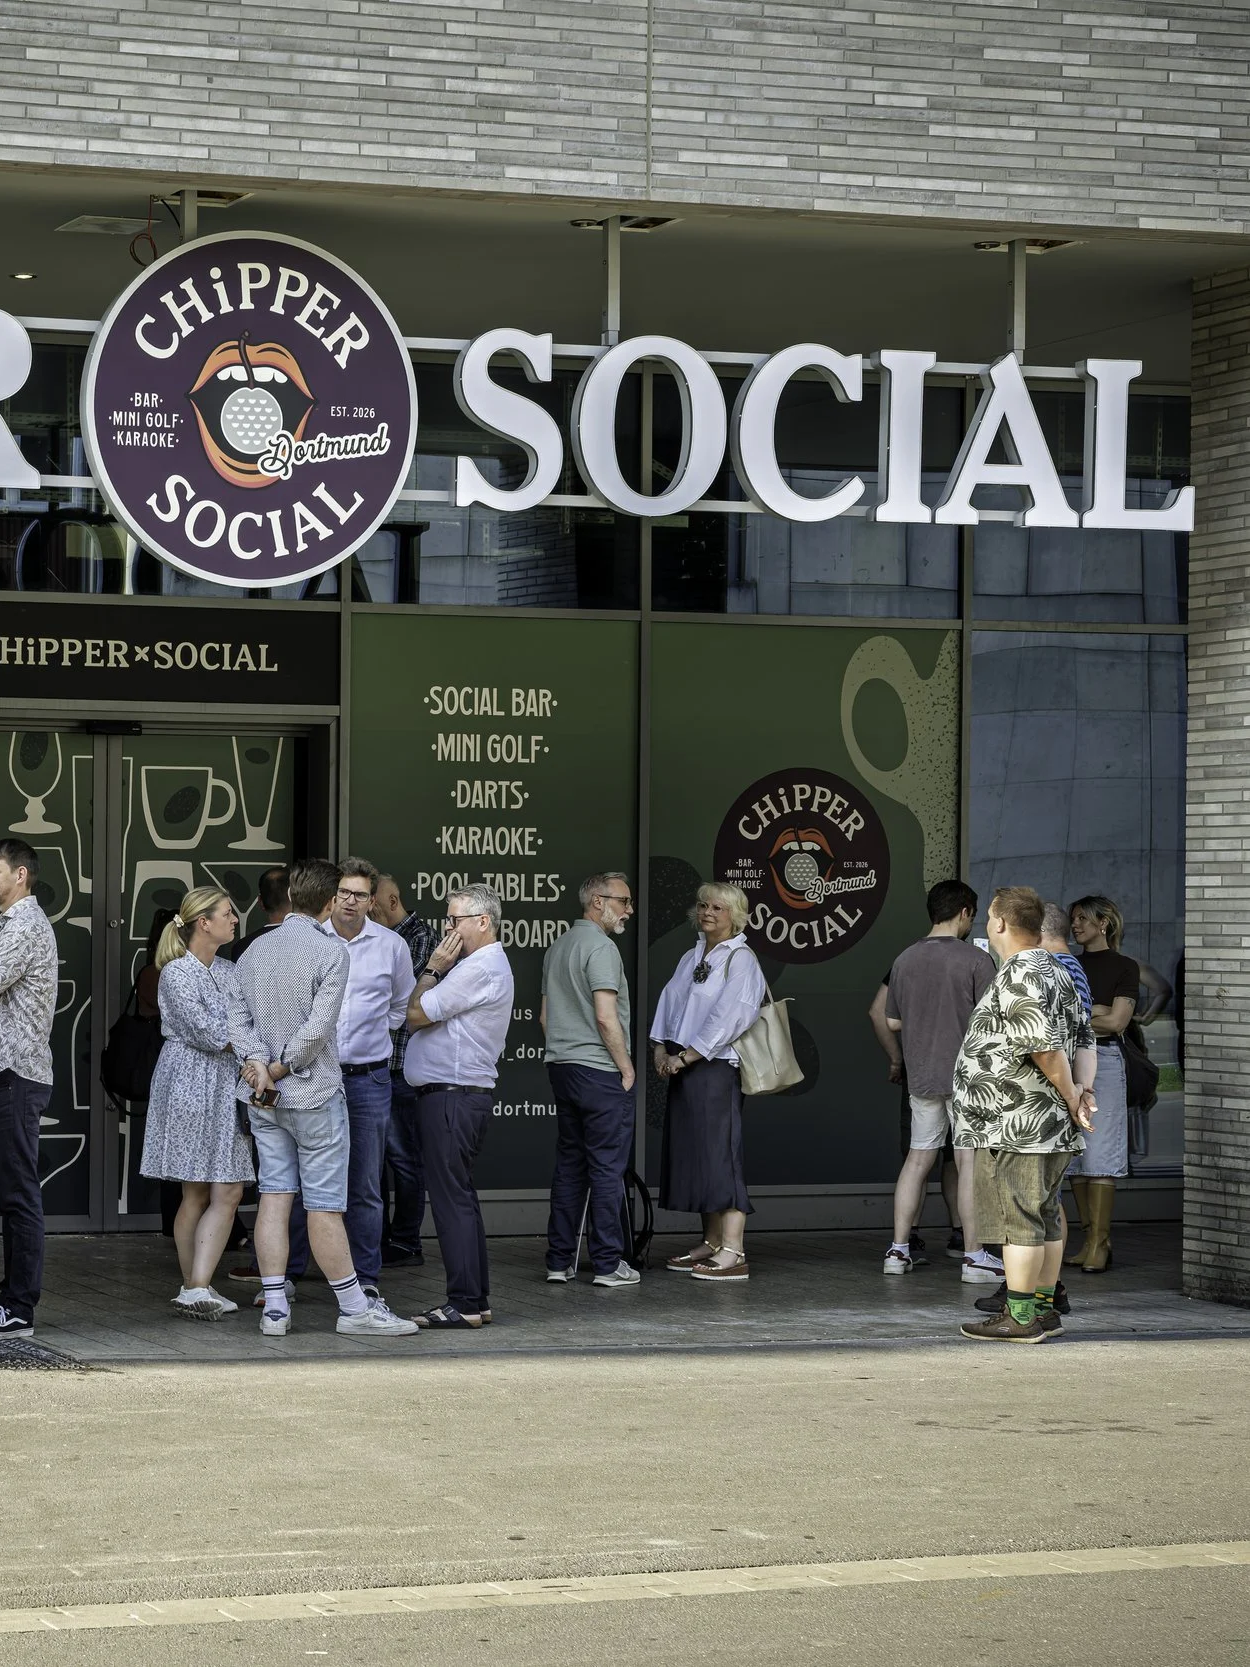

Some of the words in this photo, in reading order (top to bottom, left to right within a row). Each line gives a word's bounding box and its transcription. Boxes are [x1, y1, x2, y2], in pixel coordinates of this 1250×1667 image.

[330, 406, 350, 417] EST.
[352, 406, 376, 419] 2026
[453, 327, 1195, 532] SOCIAL
[258, 424, 389, 479] Dortmund
[145, 474, 365, 560] SOCIAL
[153, 641, 279, 672] SOCIAL
[805, 870, 876, 903] Dortmund
[749, 902, 863, 949] SOCIAL
